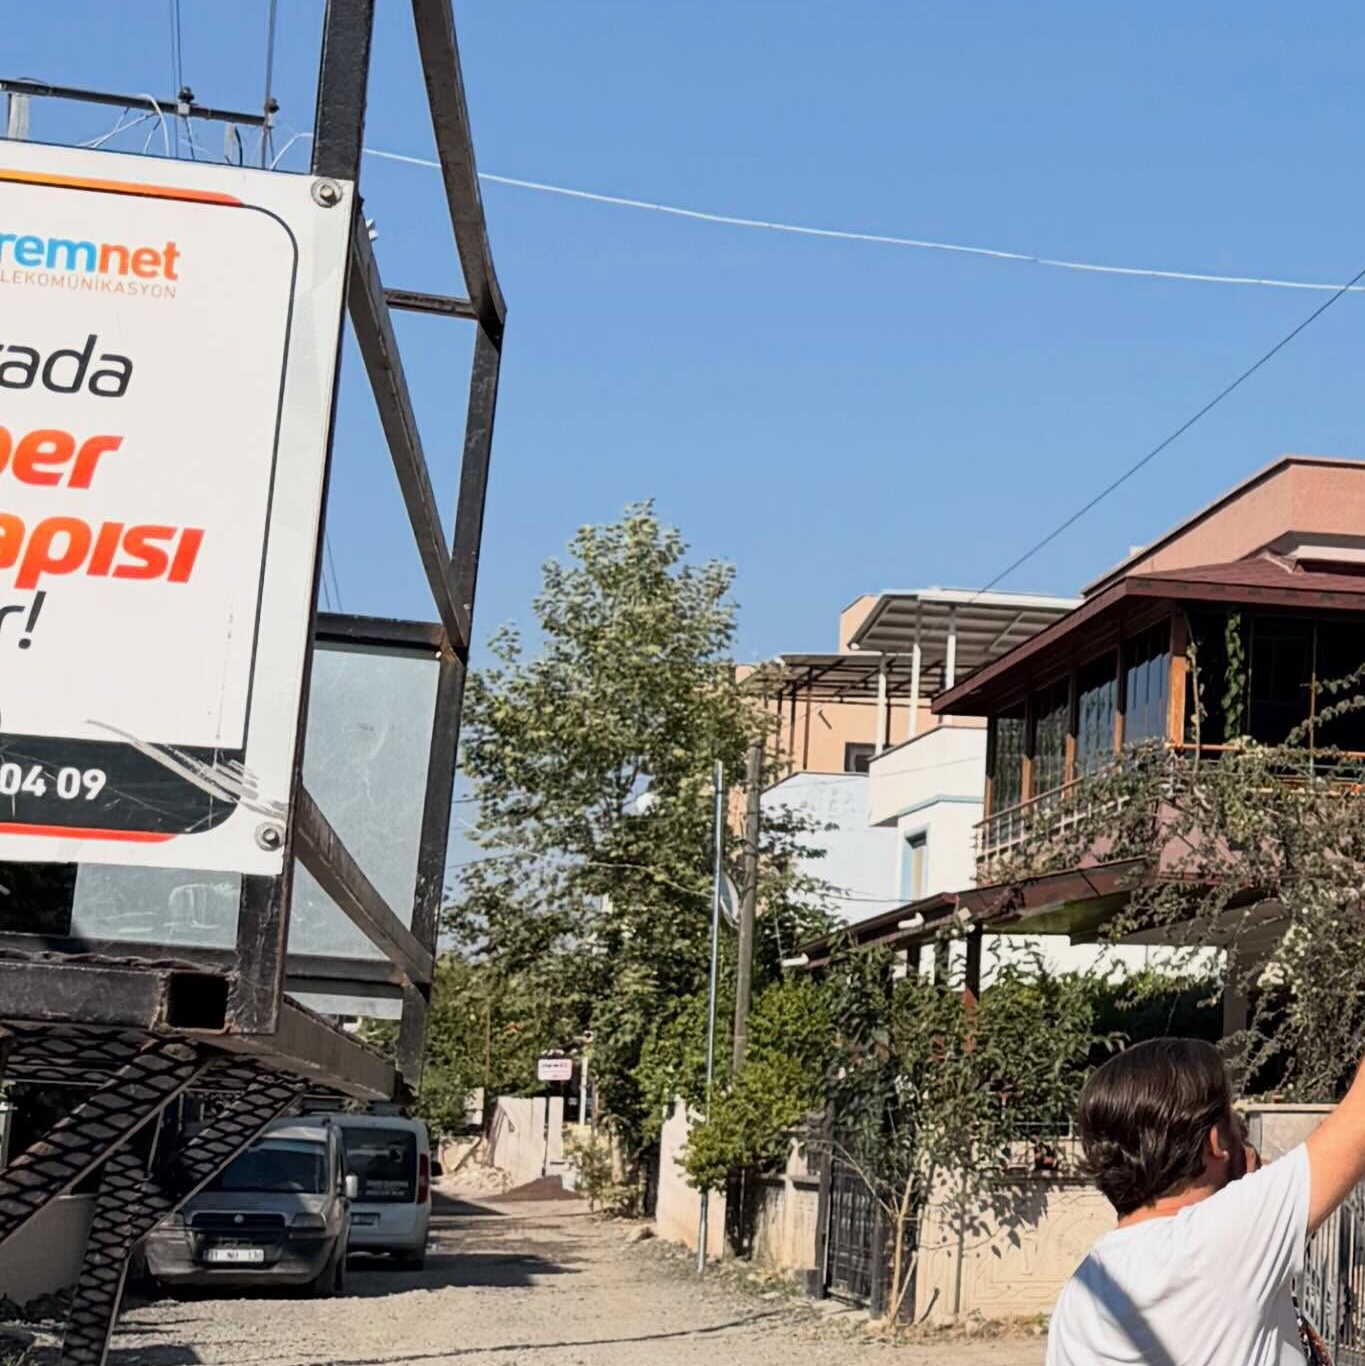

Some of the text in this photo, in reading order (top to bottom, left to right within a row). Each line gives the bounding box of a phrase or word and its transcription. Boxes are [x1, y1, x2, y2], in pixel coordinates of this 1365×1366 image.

[0, 333, 133, 397] ada
[0, 425, 124, 489] er
[0, 763, 107, 800] 04 09
